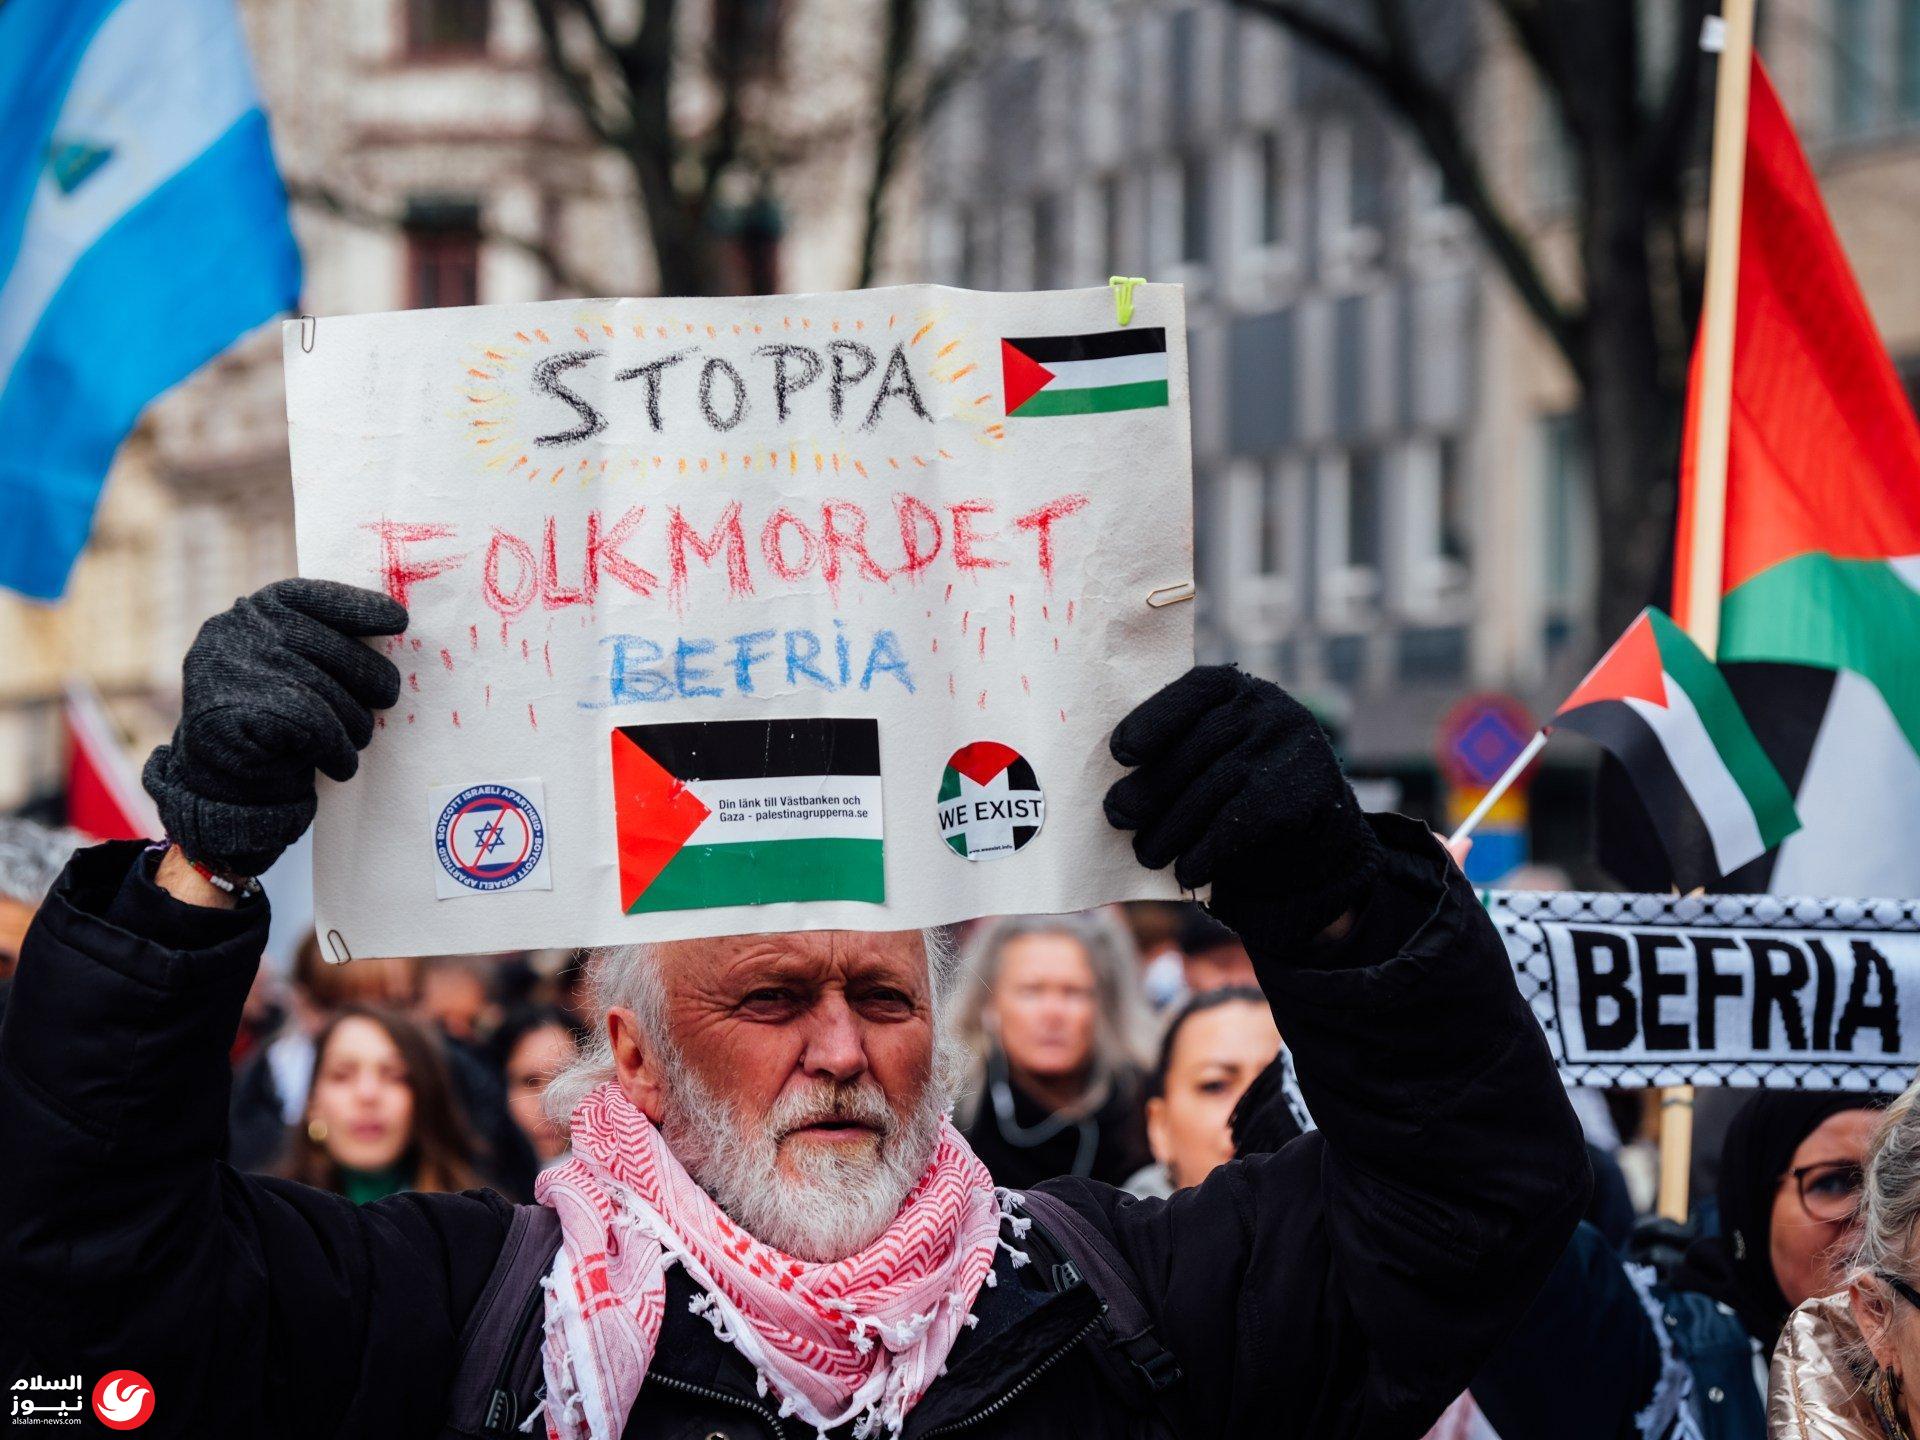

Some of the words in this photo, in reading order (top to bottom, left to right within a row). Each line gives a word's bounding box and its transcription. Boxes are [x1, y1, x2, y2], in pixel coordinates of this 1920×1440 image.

[530, 338, 935, 447] STOPPA
[358, 492, 1091, 616] FOLKMORDET
[437, 796, 463, 839] BOYCOTT
[462, 786, 500, 800] ISRAELI
[501, 787, 541, 831] APARTHEID
[719, 799, 736, 810] Din
[739, 798, 761, 808] länk
[764, 797, 778, 807] till
[780, 795, 840, 806] Västbanken
[842, 795, 861, 805] och
[719, 812, 745, 822] Gaza
[755, 808, 868, 821] palestinagrupperna.se
[939, 804, 968, 830] WE
[975, 799, 1041, 821] EXIST
[438, 846, 478, 887] APARTHEID
[517, 837, 542, 878] BOYCOTT
[478, 875, 517, 890] ISRAELI
[1569, 929, 1900, 1053] BEFRIA
